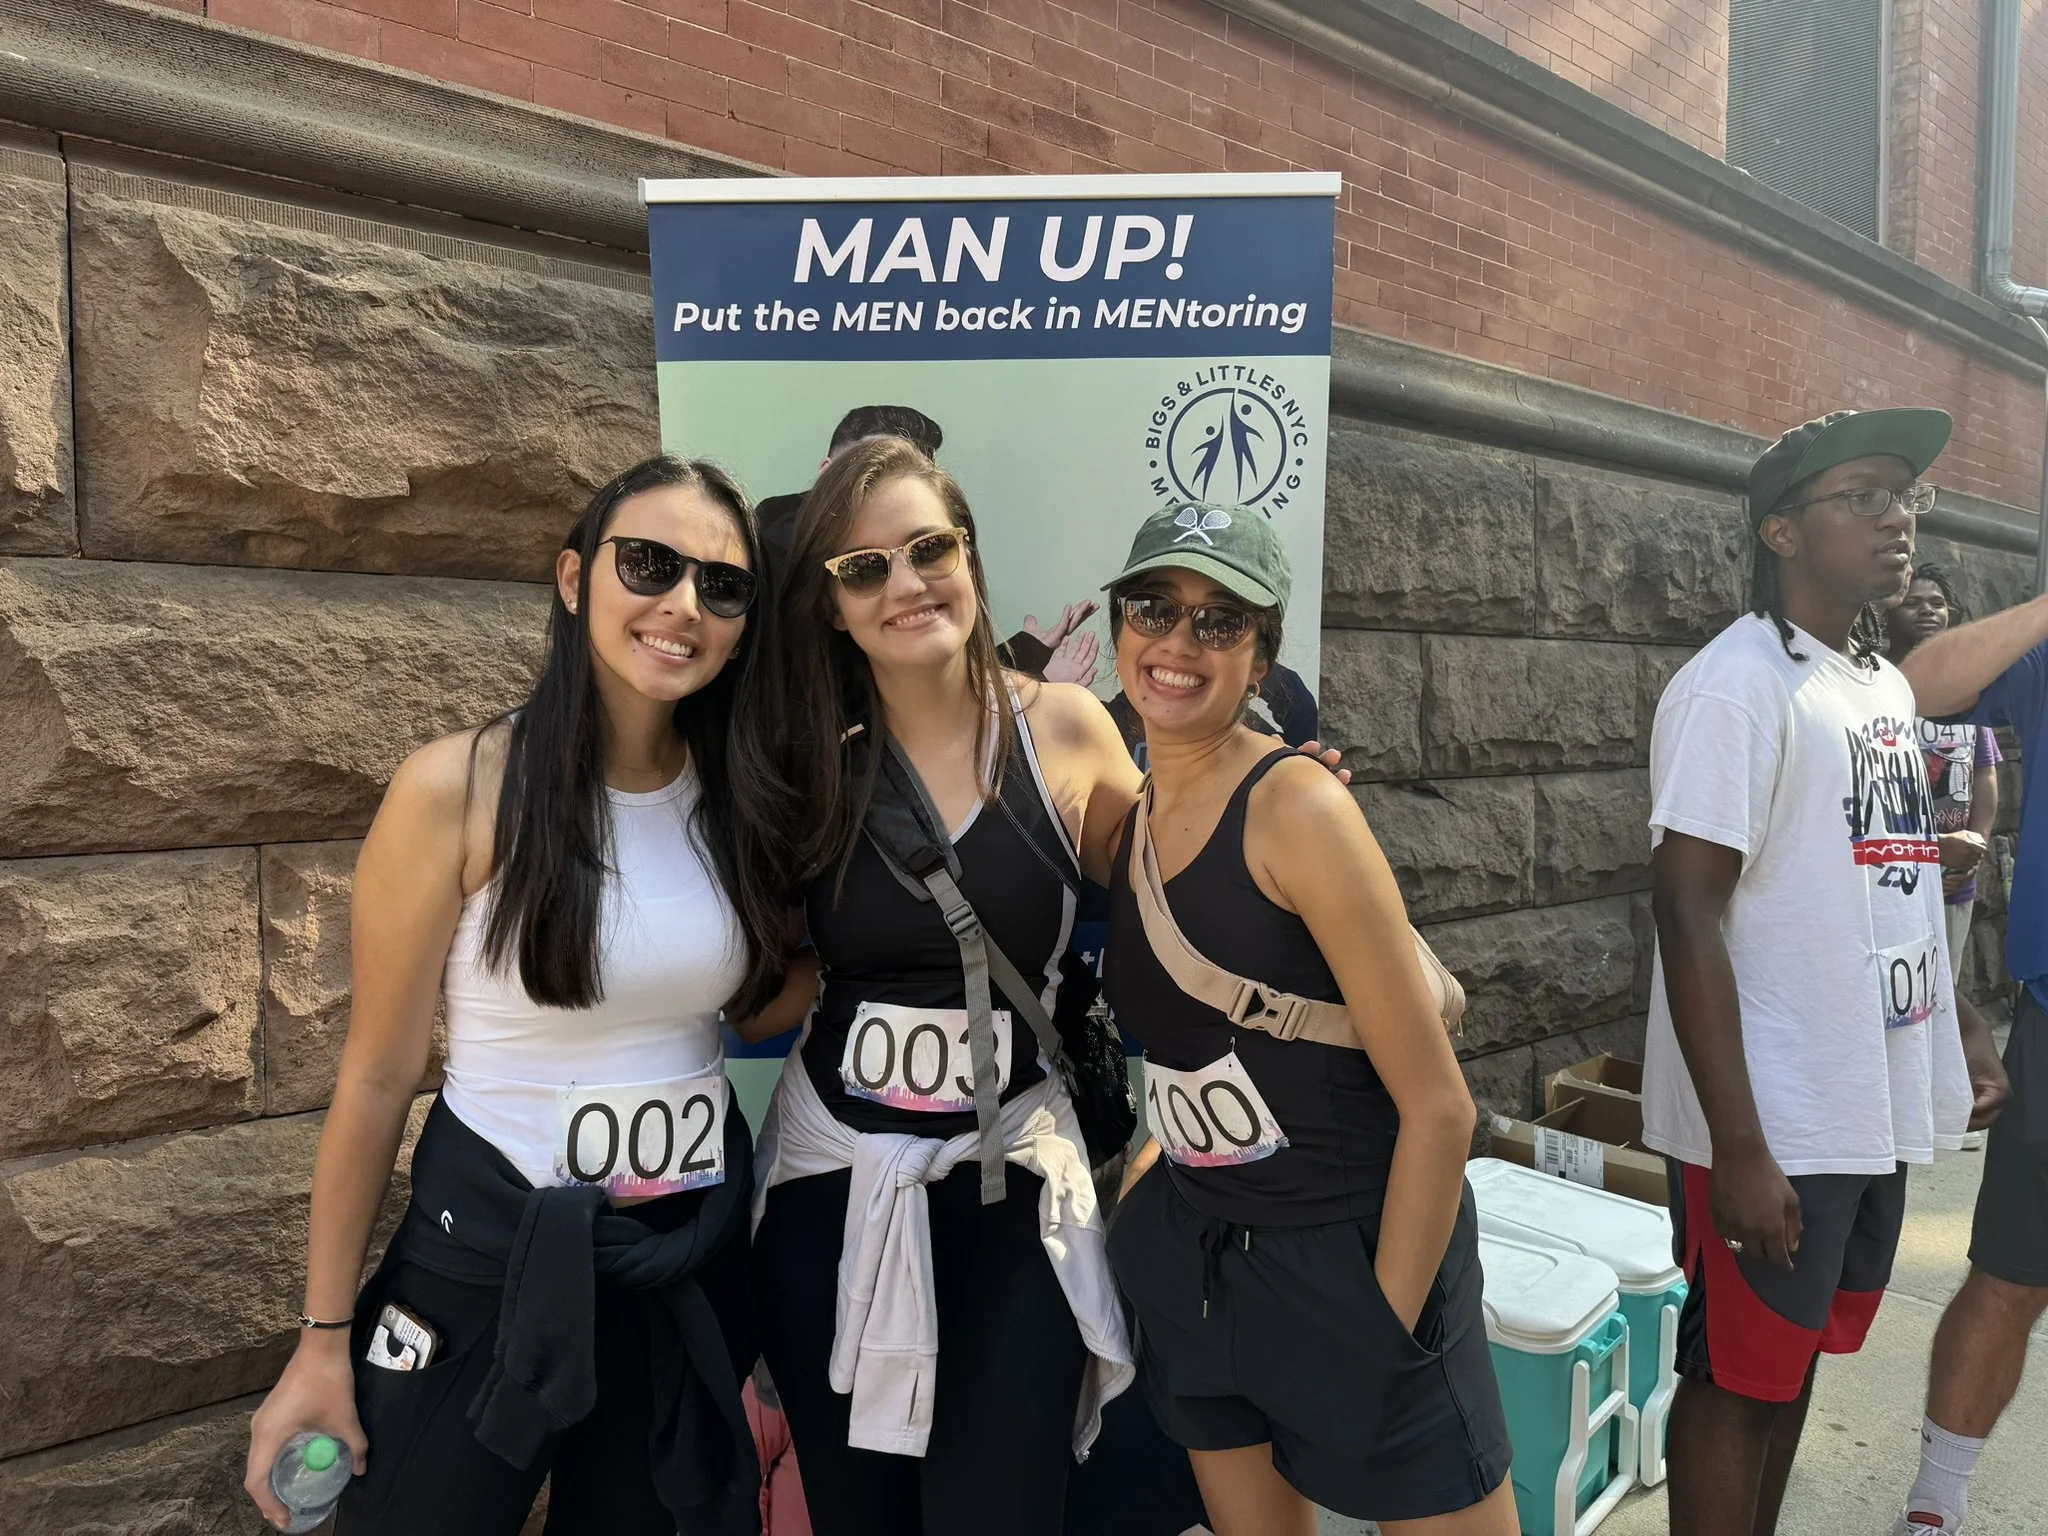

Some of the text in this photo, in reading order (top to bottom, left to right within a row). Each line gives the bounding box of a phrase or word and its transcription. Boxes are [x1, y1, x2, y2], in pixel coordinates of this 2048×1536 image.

[793, 214, 1194, 283] MAN UP!
[673, 293, 1308, 334] Put the MEN back in MENtoring
[1145, 396, 1177, 449] BIGS
[1177, 381, 1193, 396] &
[1890, 945, 1938, 1016] 012
[567, 1094, 716, 1182] 002
[1148, 1078, 1262, 1153] 100
